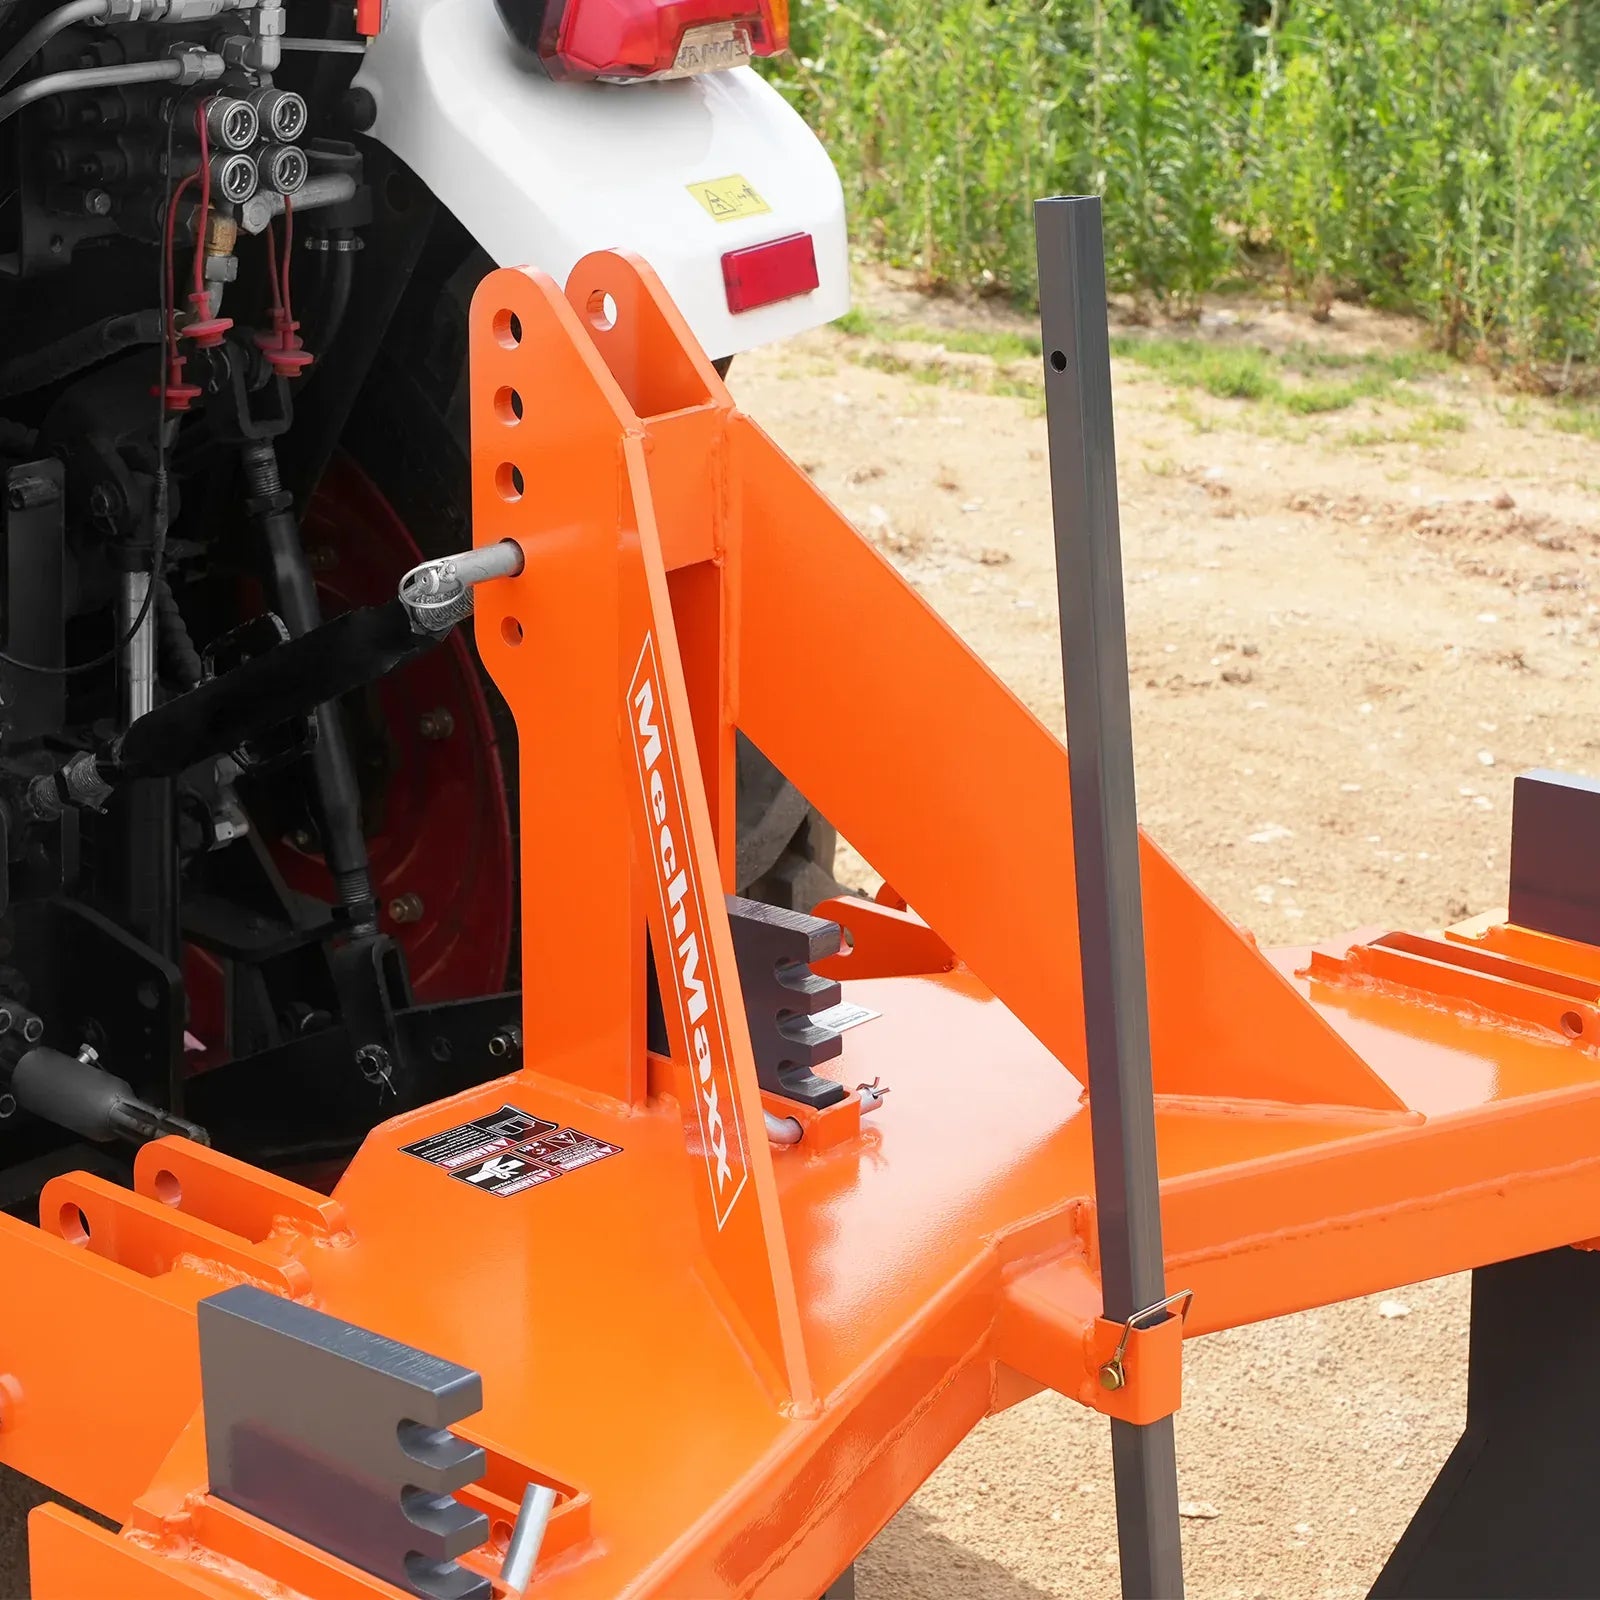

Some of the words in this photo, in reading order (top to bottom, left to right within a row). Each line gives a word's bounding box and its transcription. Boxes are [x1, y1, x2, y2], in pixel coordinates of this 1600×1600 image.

[634, 679, 732, 1195] MechMaxx
[445, 1143, 501, 1166] WARNING
[497, 1174, 545, 1194] WARNING
